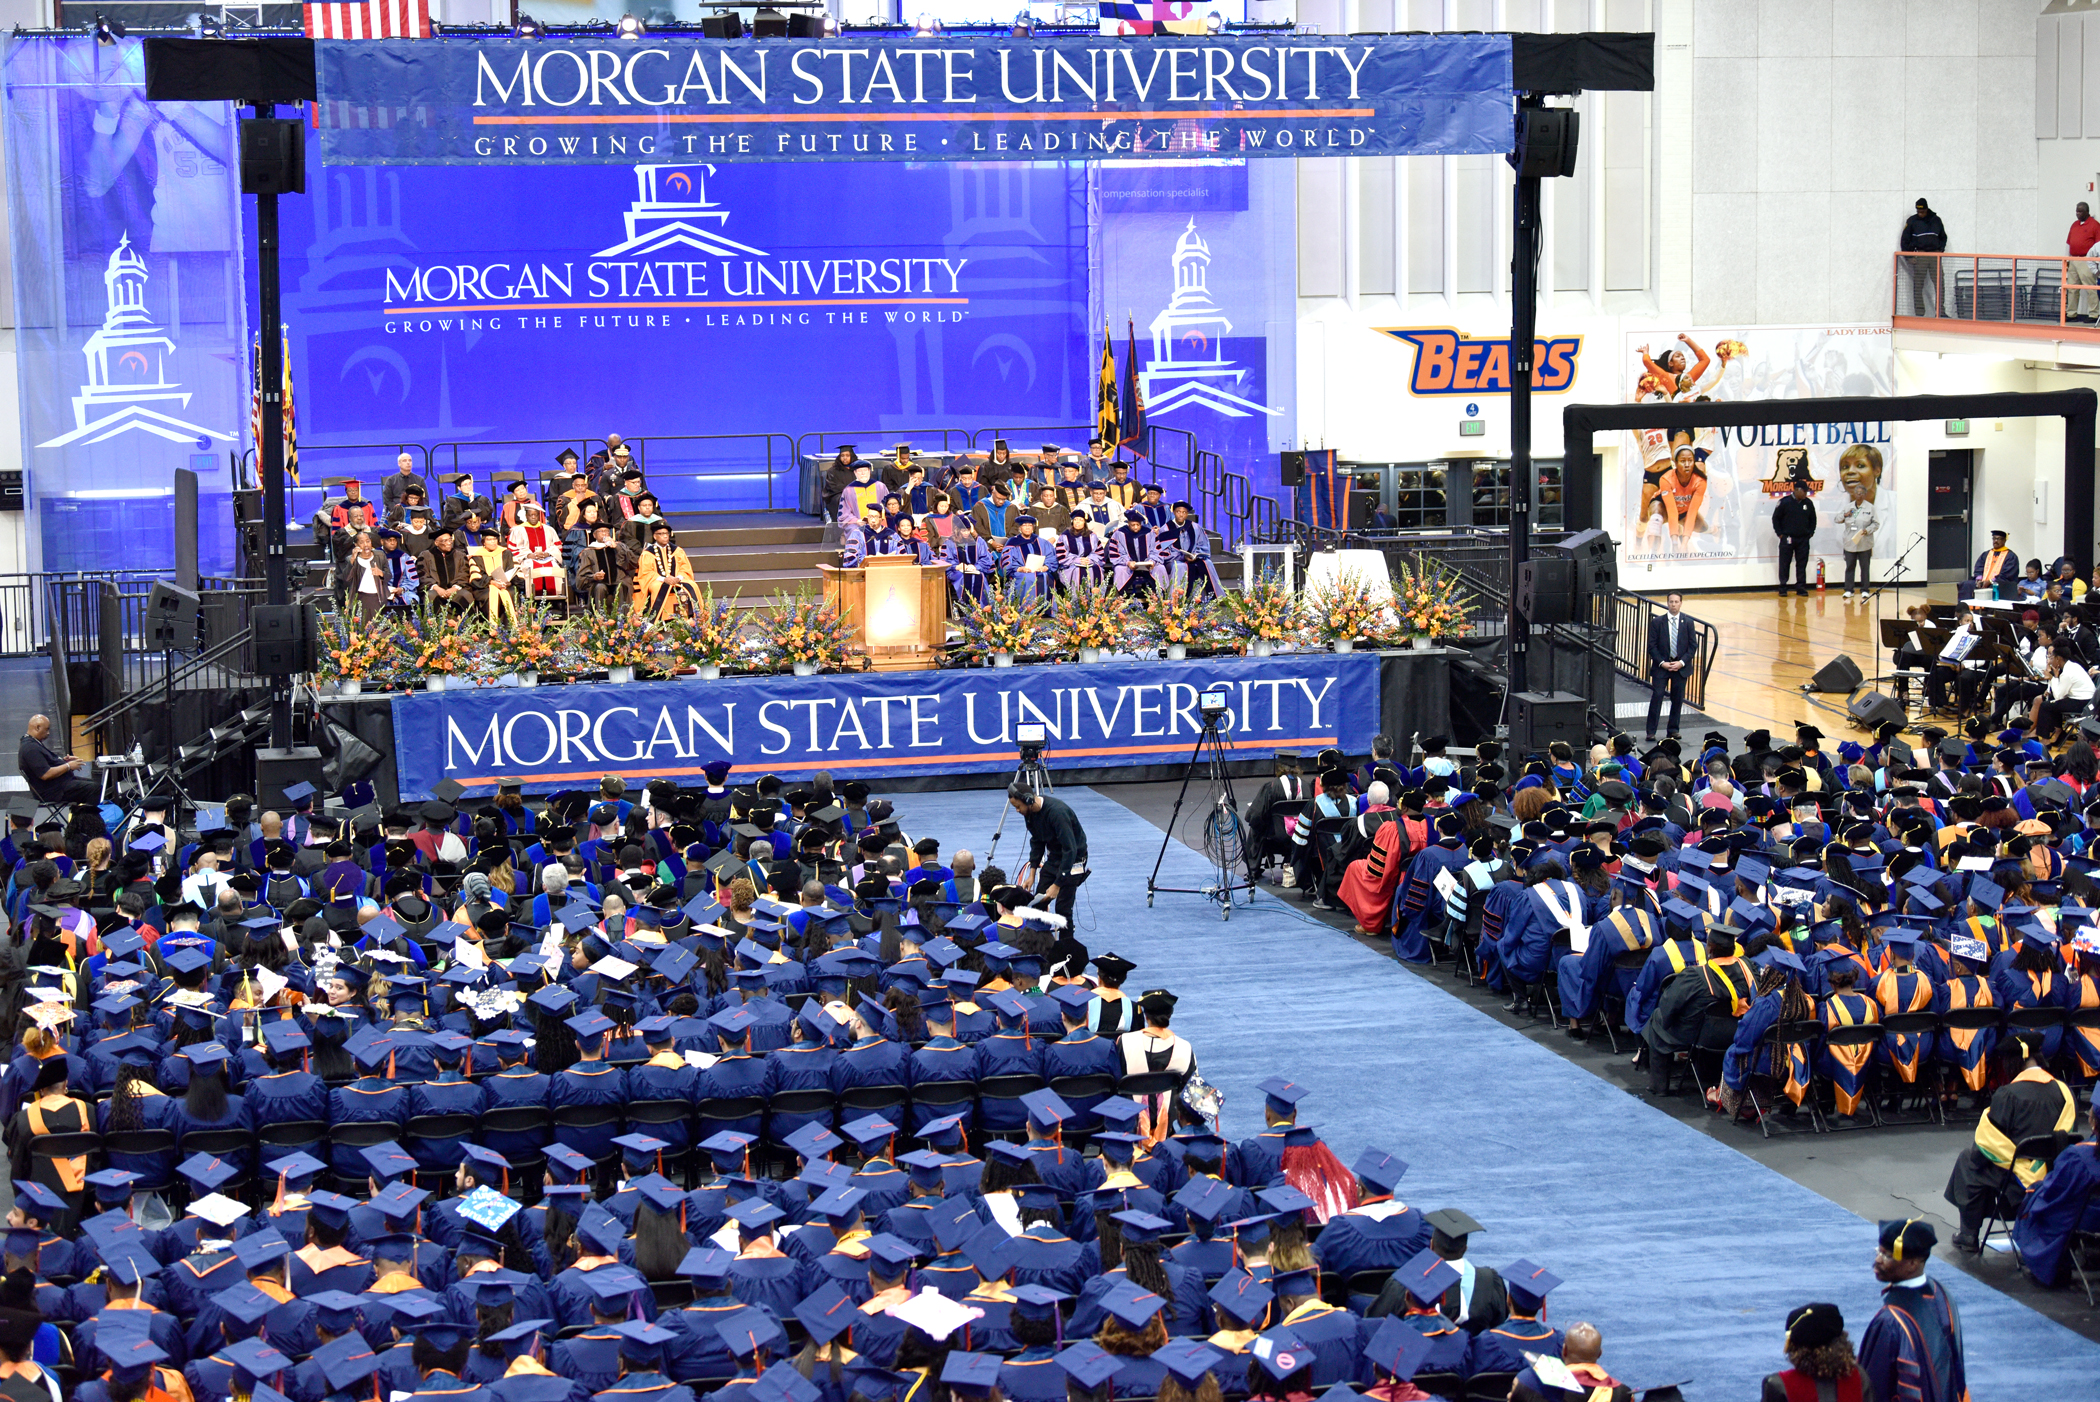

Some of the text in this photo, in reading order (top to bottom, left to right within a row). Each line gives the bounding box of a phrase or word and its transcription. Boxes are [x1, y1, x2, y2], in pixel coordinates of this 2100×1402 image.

[473, 46, 1375, 107] MORGAN STATE UNIVERSITY
[474, 128, 1366, 156] GROWING THE FUTURE LEADING THE WORLD
[1167, 187, 1210, 199] specialist
[384, 258, 969, 303] MORGAN STATE UNIVERSITY
[384, 310, 963, 334] GROWING THE FUTURE LEADING THE WORLD
[1826, 328, 1893, 336] LADY BEARS
[1466, 421, 1481, 434] EXIT
[1951, 420, 1966, 433] EXIT
[1719, 420, 1892, 448] VOLLEYBALL
[196, 456, 213, 468] EXIT
[1762, 479, 1823, 492] MORGA TATE
[1627, 553, 1667, 561] EXCELLENCE
[1676, 552, 1689, 560] THE
[1689, 550, 1734, 559] EXPECTATION
[444, 676, 1338, 771] MORGAN STATE UNIVERSITY
